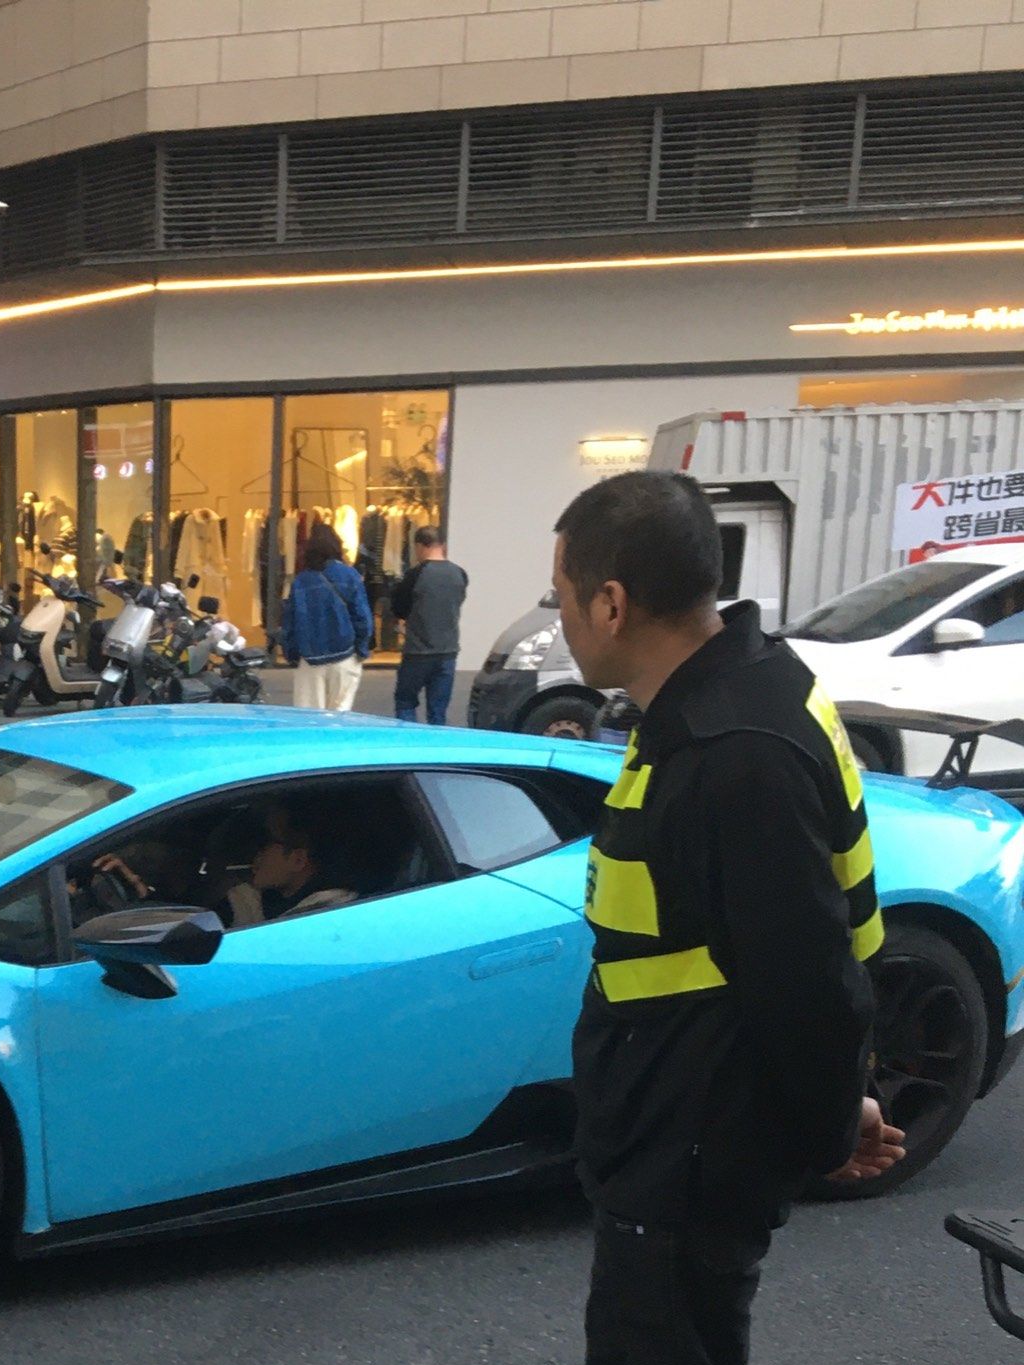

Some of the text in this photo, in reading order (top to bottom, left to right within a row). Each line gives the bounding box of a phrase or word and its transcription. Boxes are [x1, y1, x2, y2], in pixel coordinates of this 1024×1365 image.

[911, 473, 1024, 511] 大件也要
[943, 506, 1024, 541] 跨省最
